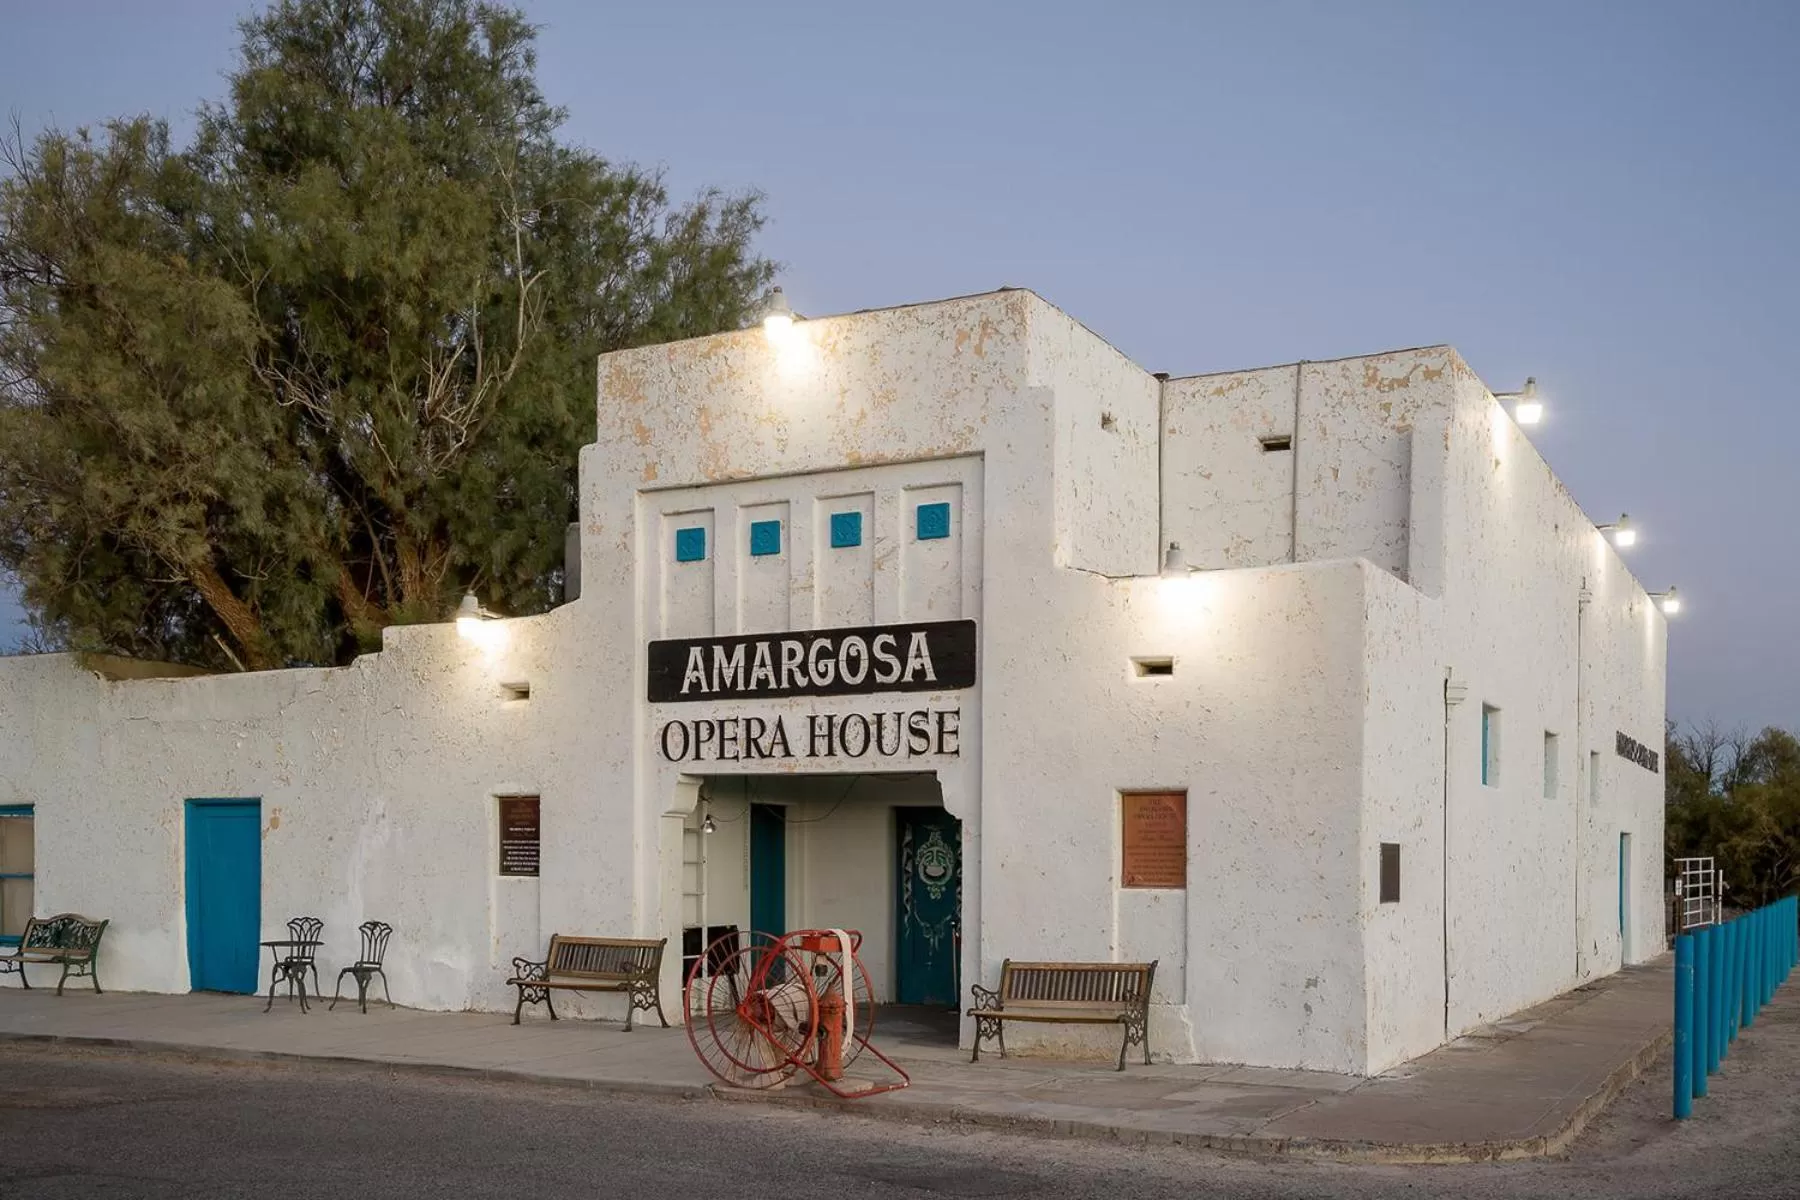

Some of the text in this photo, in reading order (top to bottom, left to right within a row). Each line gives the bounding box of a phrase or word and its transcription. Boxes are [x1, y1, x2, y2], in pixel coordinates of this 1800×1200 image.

[680, 631, 937, 694] AMARGOSA
[661, 707, 961, 762] OPERA HOUSE
